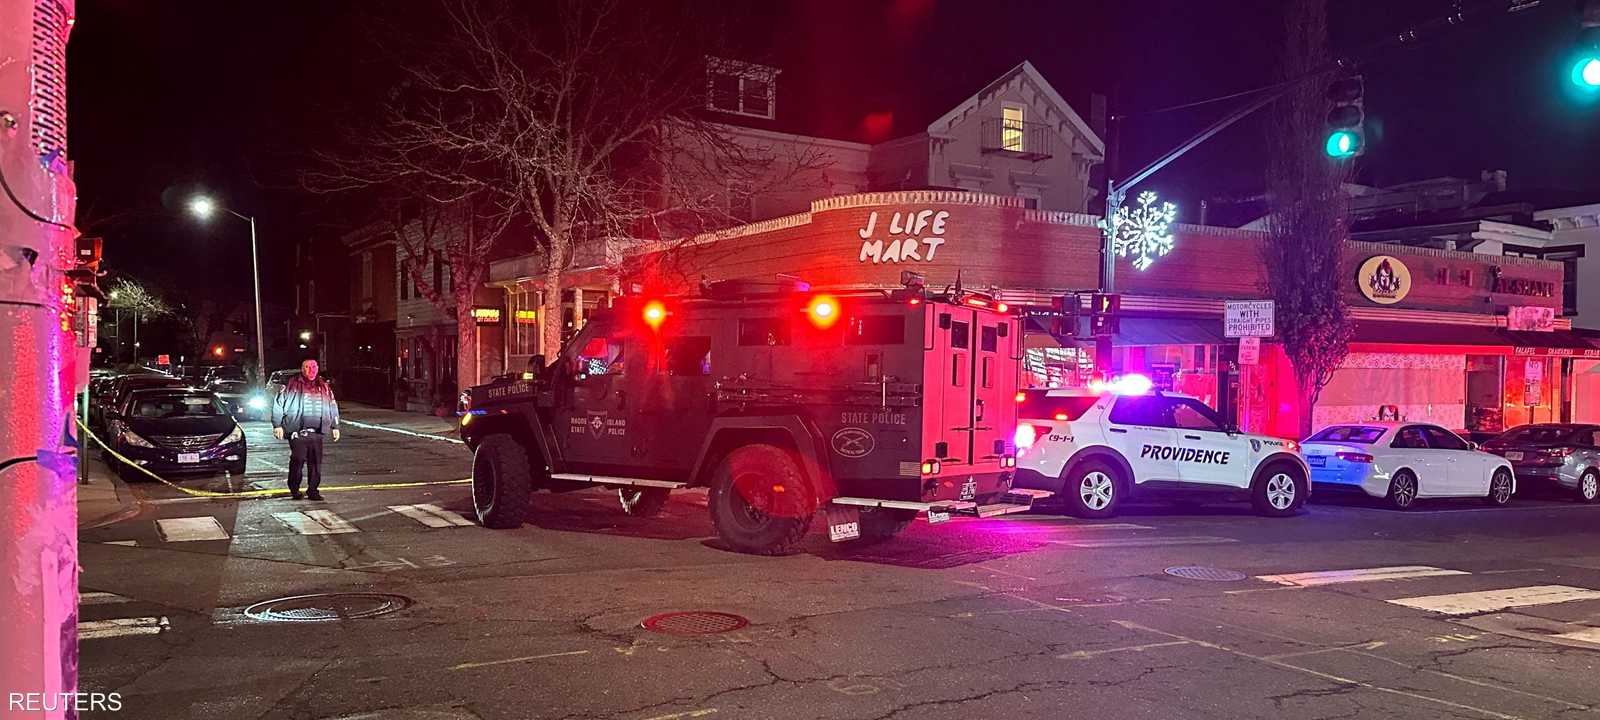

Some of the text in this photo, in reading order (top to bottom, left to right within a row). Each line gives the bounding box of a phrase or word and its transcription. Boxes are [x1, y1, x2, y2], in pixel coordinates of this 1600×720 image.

[859, 209, 950, 239] J LIFE
[859, 237, 945, 264] MART
[1240, 310, 1259, 318] WITH
[488, 384, 529, 398] STATE POLICE
[570, 417, 587, 425] RHODE
[607, 419, 626, 427] ISLAND
[841, 412, 906, 425] STATE POLICE
[570, 426, 585, 434] STATE
[608, 428, 625, 436] POLICE
[1140, 444, 1230, 465] PROVIDENCE
[830, 522, 858, 535] LENCO
